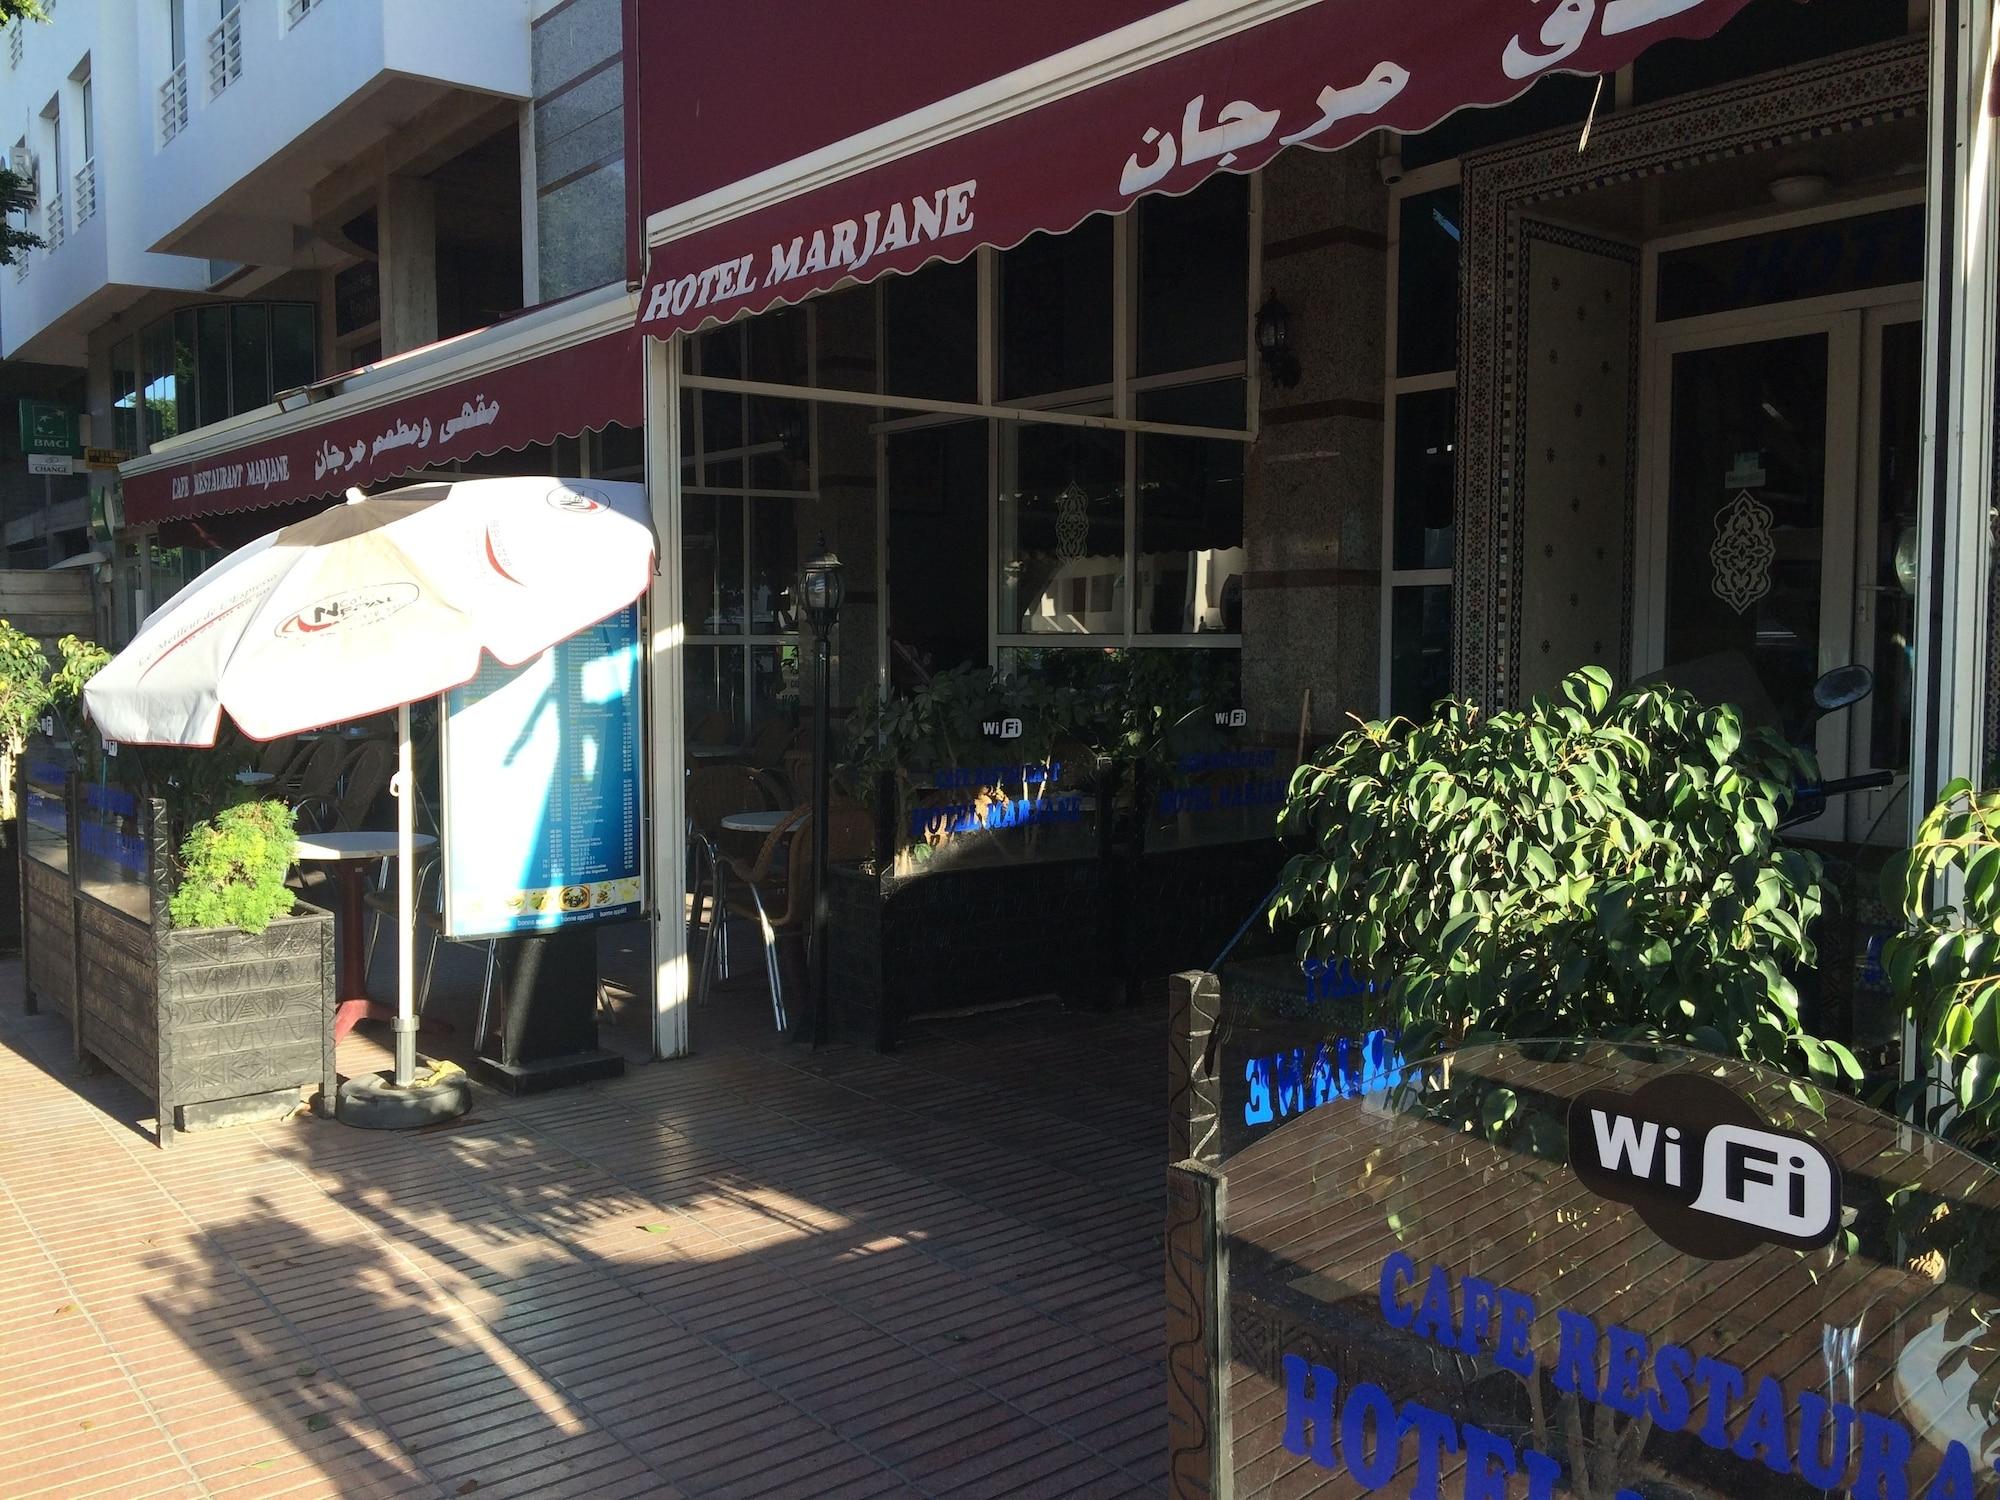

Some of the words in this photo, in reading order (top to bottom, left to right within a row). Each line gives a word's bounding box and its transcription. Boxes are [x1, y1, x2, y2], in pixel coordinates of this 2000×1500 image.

[641, 253, 757, 322] HOTEL
[763, 179, 977, 289] MARJANE
[34, 439, 69, 448] BMCI
[35, 465, 68, 473] CHANGE
[172, 476, 189, 500] CAFE
[193, 463, 243, 496] RESTAURANT
[246, 455, 290, 490] MARJANE
[1379, 1251, 1537, 1377] CAFE
[1553, 1308, 2000, 1500] RESTAURA
